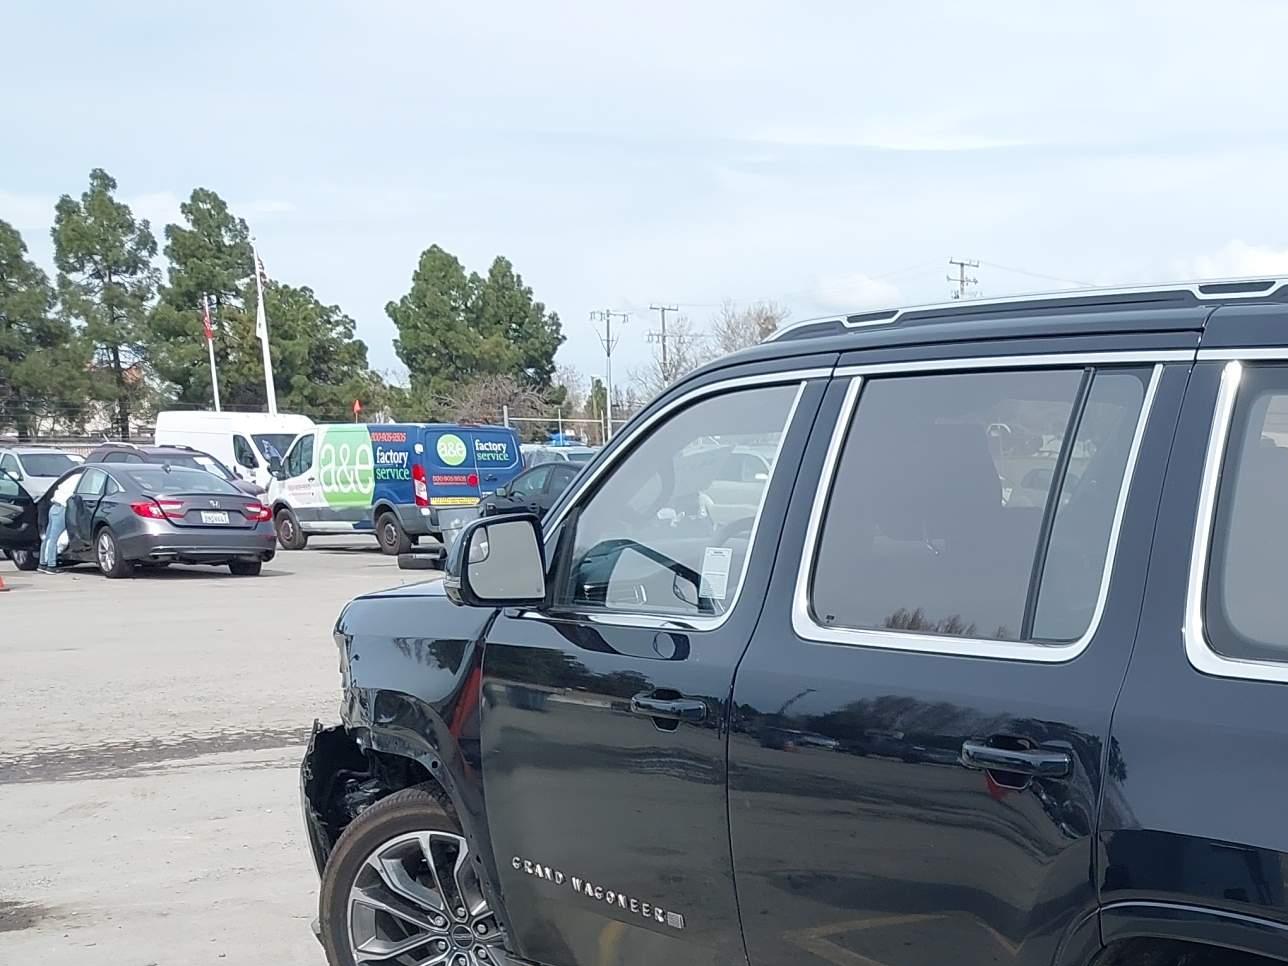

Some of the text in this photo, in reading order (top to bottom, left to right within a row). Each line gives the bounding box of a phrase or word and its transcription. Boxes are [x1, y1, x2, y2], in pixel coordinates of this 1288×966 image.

[439, 441, 465, 457] a&e
[475, 439, 507, 453] factory
[376, 447, 409, 468] factory
[476, 452, 510, 461] service
[320, 443, 372, 494] a&e
[376, 468, 410, 480] service
[511, 856, 666, 923] GRAND WAGONEER
